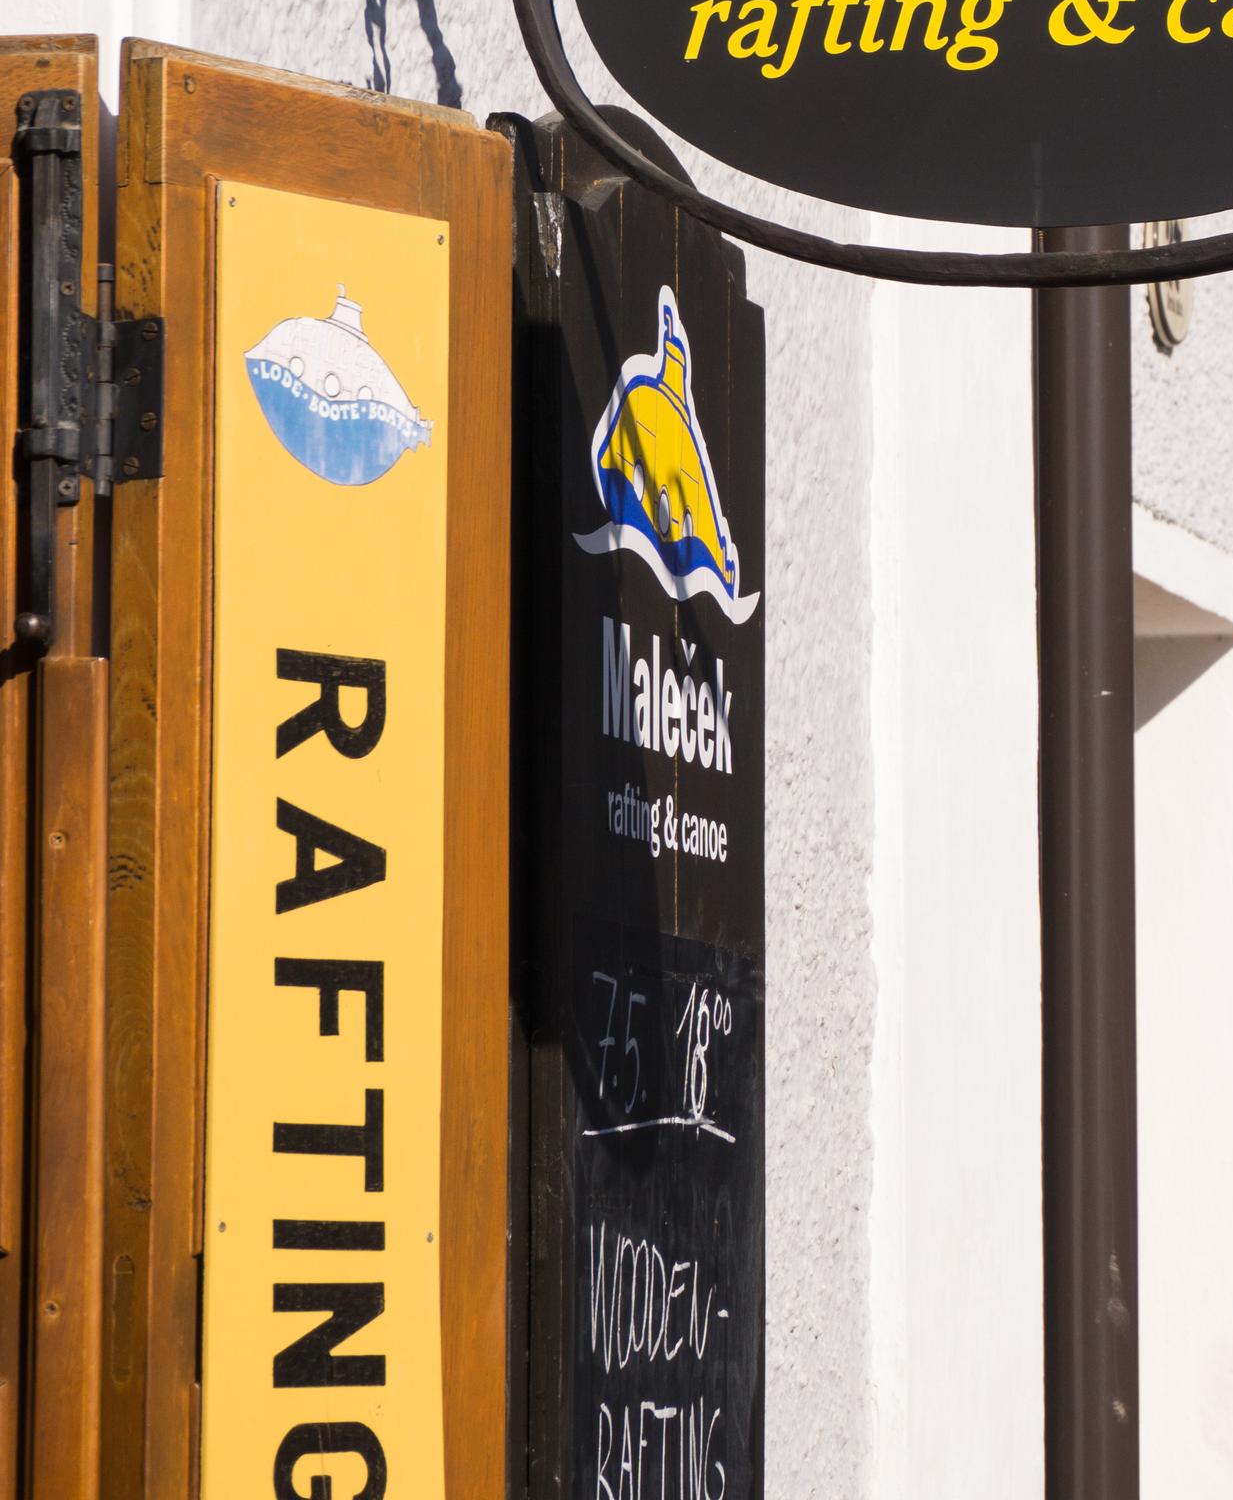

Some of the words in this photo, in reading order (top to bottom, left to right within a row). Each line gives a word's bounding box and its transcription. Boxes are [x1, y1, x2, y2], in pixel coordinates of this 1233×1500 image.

[602, 615, 733, 775] Maleček
[608, 782, 660, 859] rafting
[663, 795, 679, 851] &
[681, 811, 728, 863] canoe
[272, 647, 388, 1500] RAFTING
[597, 1396, 726, 1500] RAFTING
